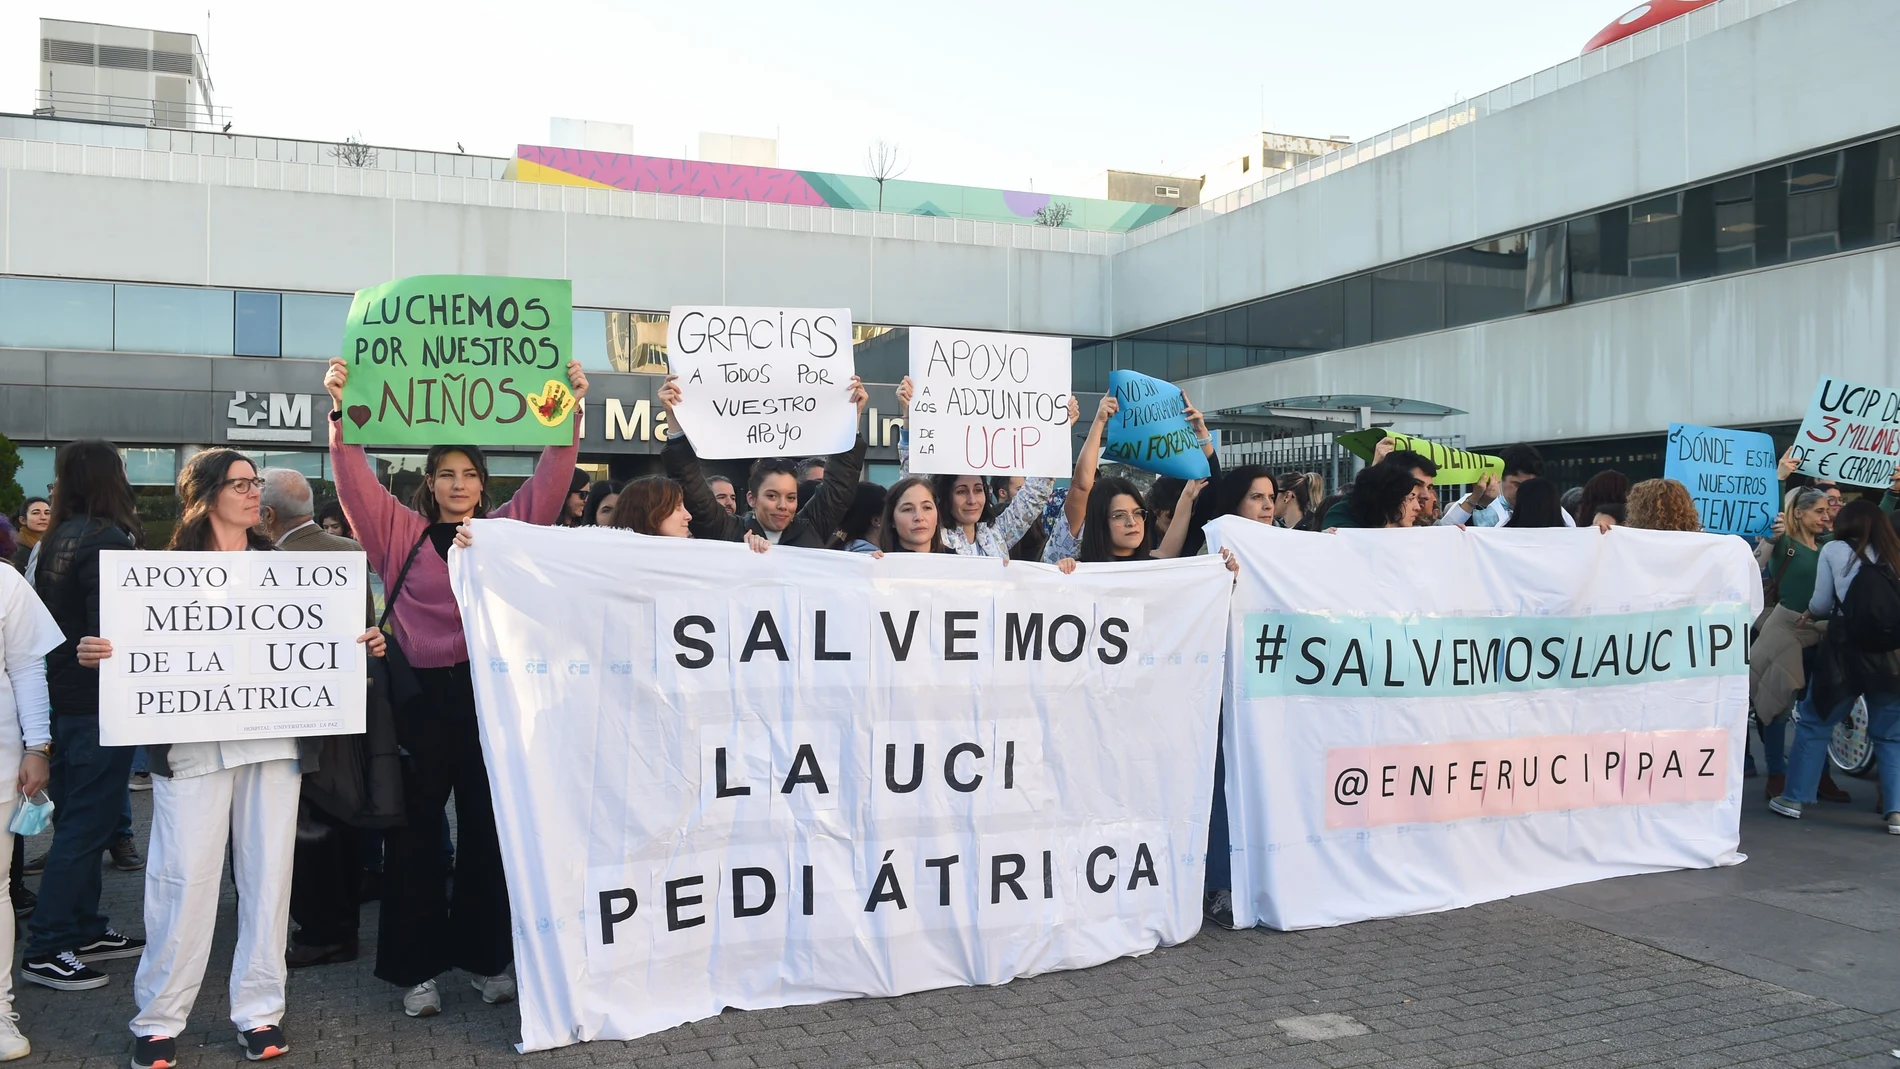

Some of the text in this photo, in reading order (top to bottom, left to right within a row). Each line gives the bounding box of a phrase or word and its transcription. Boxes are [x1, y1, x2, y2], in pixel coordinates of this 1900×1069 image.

[362, 293, 551, 331] LUCHEMOS
[355, 335, 559, 370] POR NUESTROS
[927, 340, 1029, 383] APOYO
[689, 362, 834, 385] A TODOS POR
[378, 373, 528, 427] NIÑOS
[712, 396, 816, 416] VUESTRO
[914, 400, 937, 413] LOS
[922, 386, 931, 396] A
[946, 387, 1069, 425] ADJUNTOS
[1115, 379, 1141, 403] NO
[1819, 380, 1881, 418] UCIP
[746, 422, 802, 450] APOYO
[919, 429, 935, 439] DE
[1806, 415, 1841, 443] 3
[919, 443, 935, 454] LA
[1109, 441, 1142, 460] SON
[1669, 425, 1735, 466] ¿DÓNDE
[1791, 445, 1815, 471] DE
[1818, 452, 1838, 476] €
[1698, 473, 1767, 495] NUESTROS
[121, 565, 348, 587] APOYO A LOS
[144, 600, 324, 632] MÉDICOS
[673, 609, 1131, 669] SALVEMOS
[128, 642, 339, 673] DE LA UCI
[136, 684, 334, 715] PEDIÁTRICA
[273, 723, 317, 731] UNIVERSITARIO
[715, 740, 1015, 798] LA UCI
[1333, 748, 1716, 806] @ENFERUCIPPAZ
[598, 842, 1160, 945] PEDIÁTRICA
